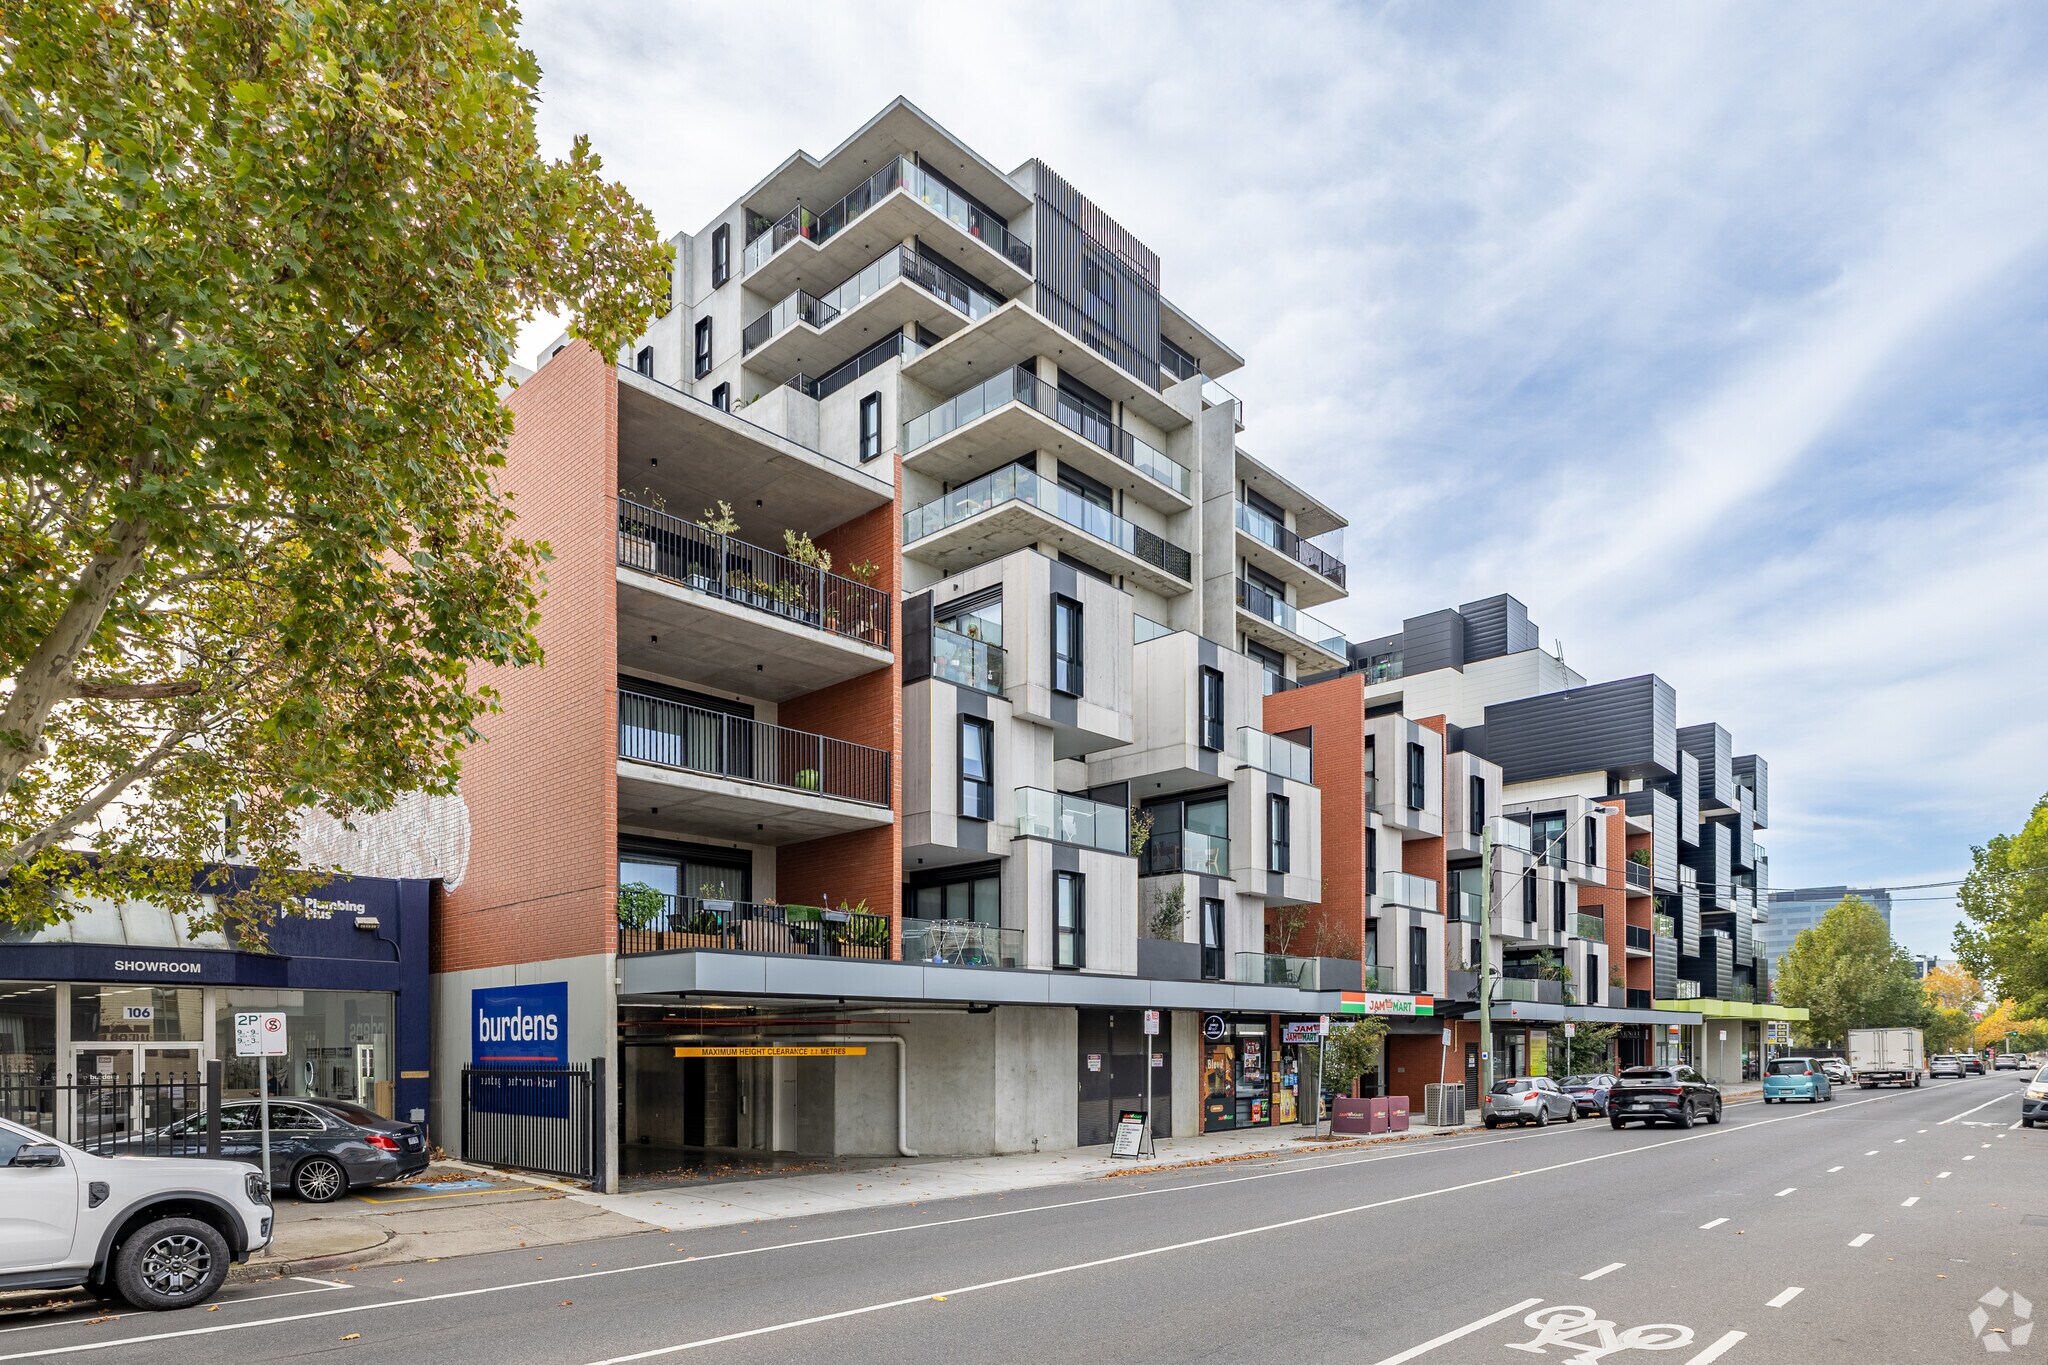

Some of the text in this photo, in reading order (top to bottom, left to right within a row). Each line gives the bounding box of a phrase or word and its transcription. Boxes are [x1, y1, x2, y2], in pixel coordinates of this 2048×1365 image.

[304, 898, 365, 915] Plumbing
[114, 960, 201, 973] SHOWROOM
[1369, 1000, 1412, 1012] JAM MART
[127, 1007, 151, 1018] 106
[238, 1015, 258, 1026] 2P
[479, 1006, 558, 1042] burdens
[1285, 1033, 1317, 1041] JAM MART
[701, 1048, 738, 1056] MAXIMUM
[740, 1048, 765, 1056] HEIGHT
[767, 1048, 808, 1056] CLEARANCE
[820, 1047, 846, 1055] METRES
